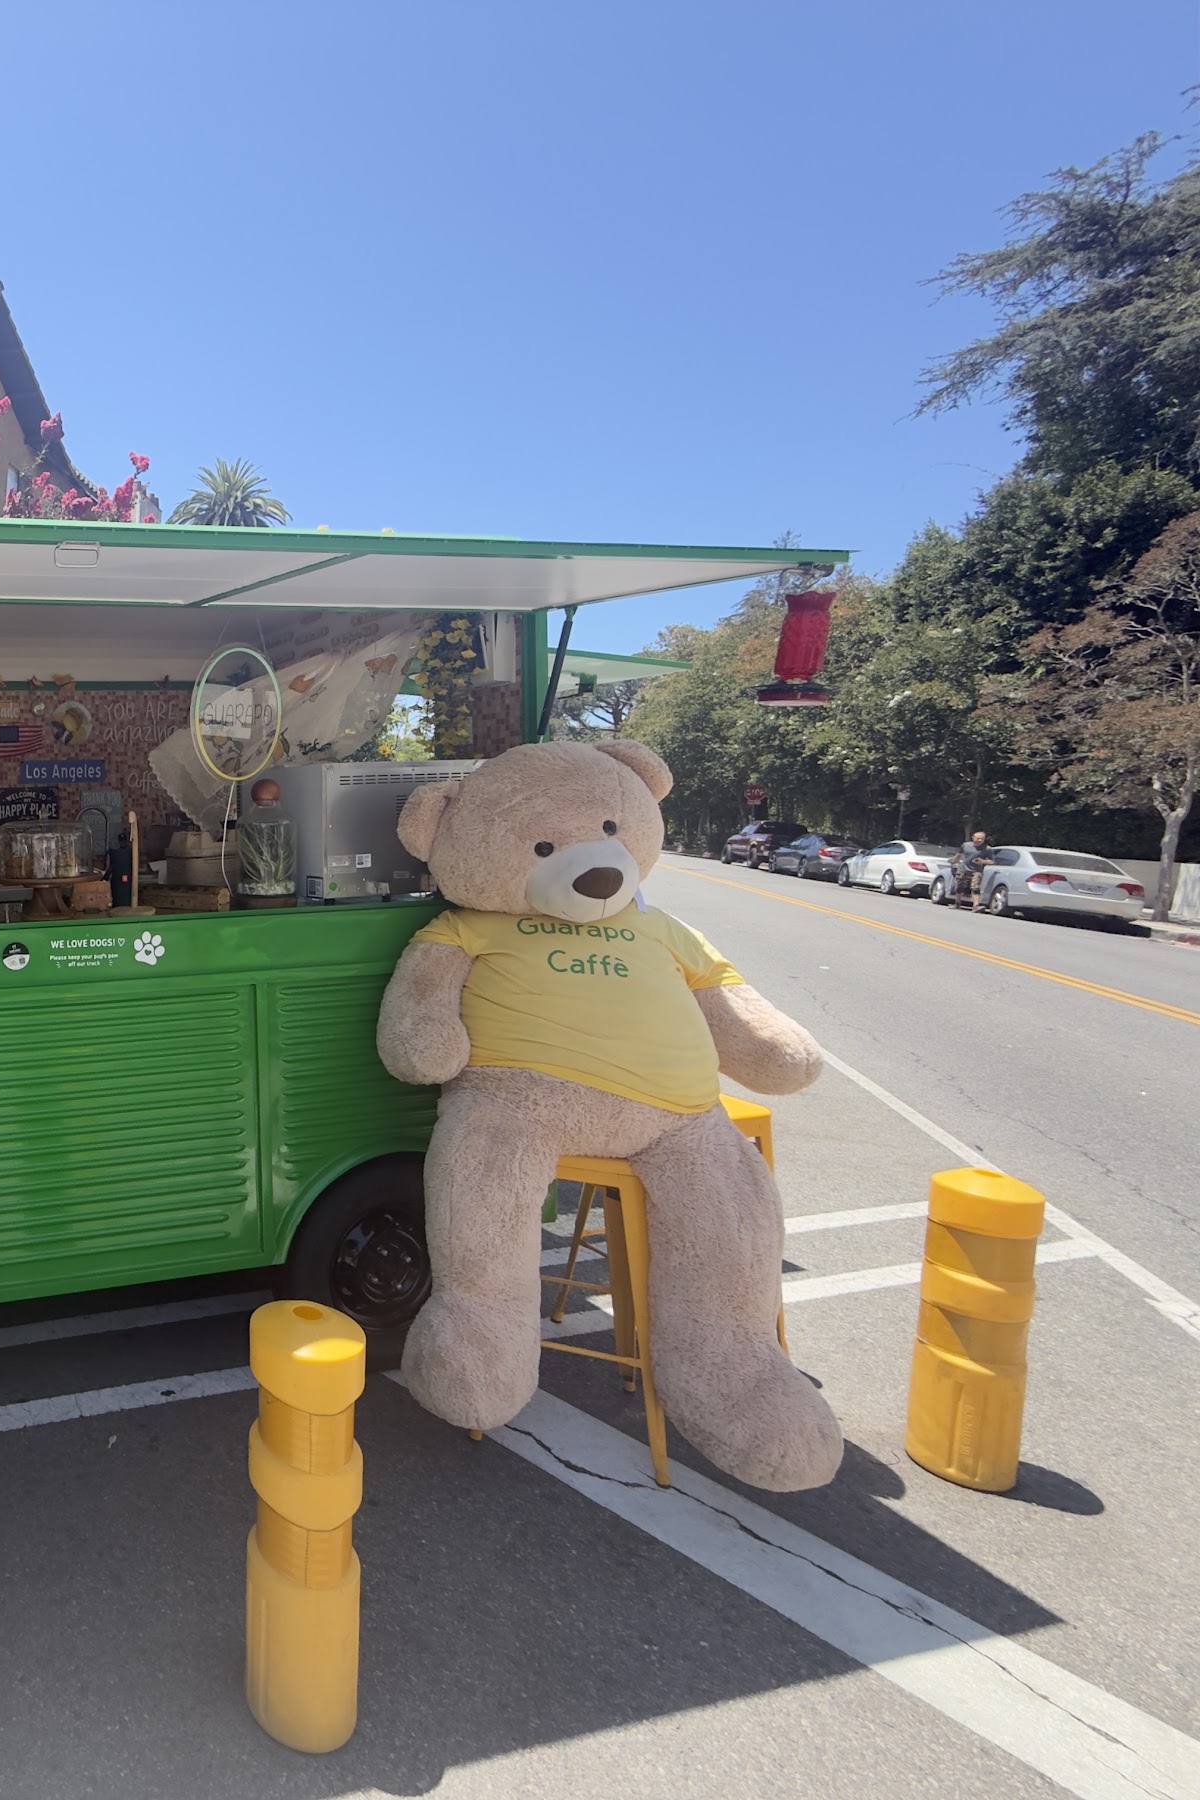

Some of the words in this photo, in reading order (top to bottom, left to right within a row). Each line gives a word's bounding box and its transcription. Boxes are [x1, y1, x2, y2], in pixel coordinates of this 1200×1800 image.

[104, 702, 134, 722] YOU
[145, 701, 176, 720] ARE
[202, 703, 273, 726] GUARAPO
[25, 764, 48, 779] Los
[51, 764, 102, 782] Angeles
[127, 770, 160, 794] Coffe
[5, 791, 37, 802] WELCOME
[39, 792, 47, 800] TO
[516, 917, 636, 942] Guarapo
[50, 940, 65, 949] WE
[66, 939, 88, 948] LOVE
[89, 938, 116, 947] DOGS!
[547, 949, 629, 978] Caffè
